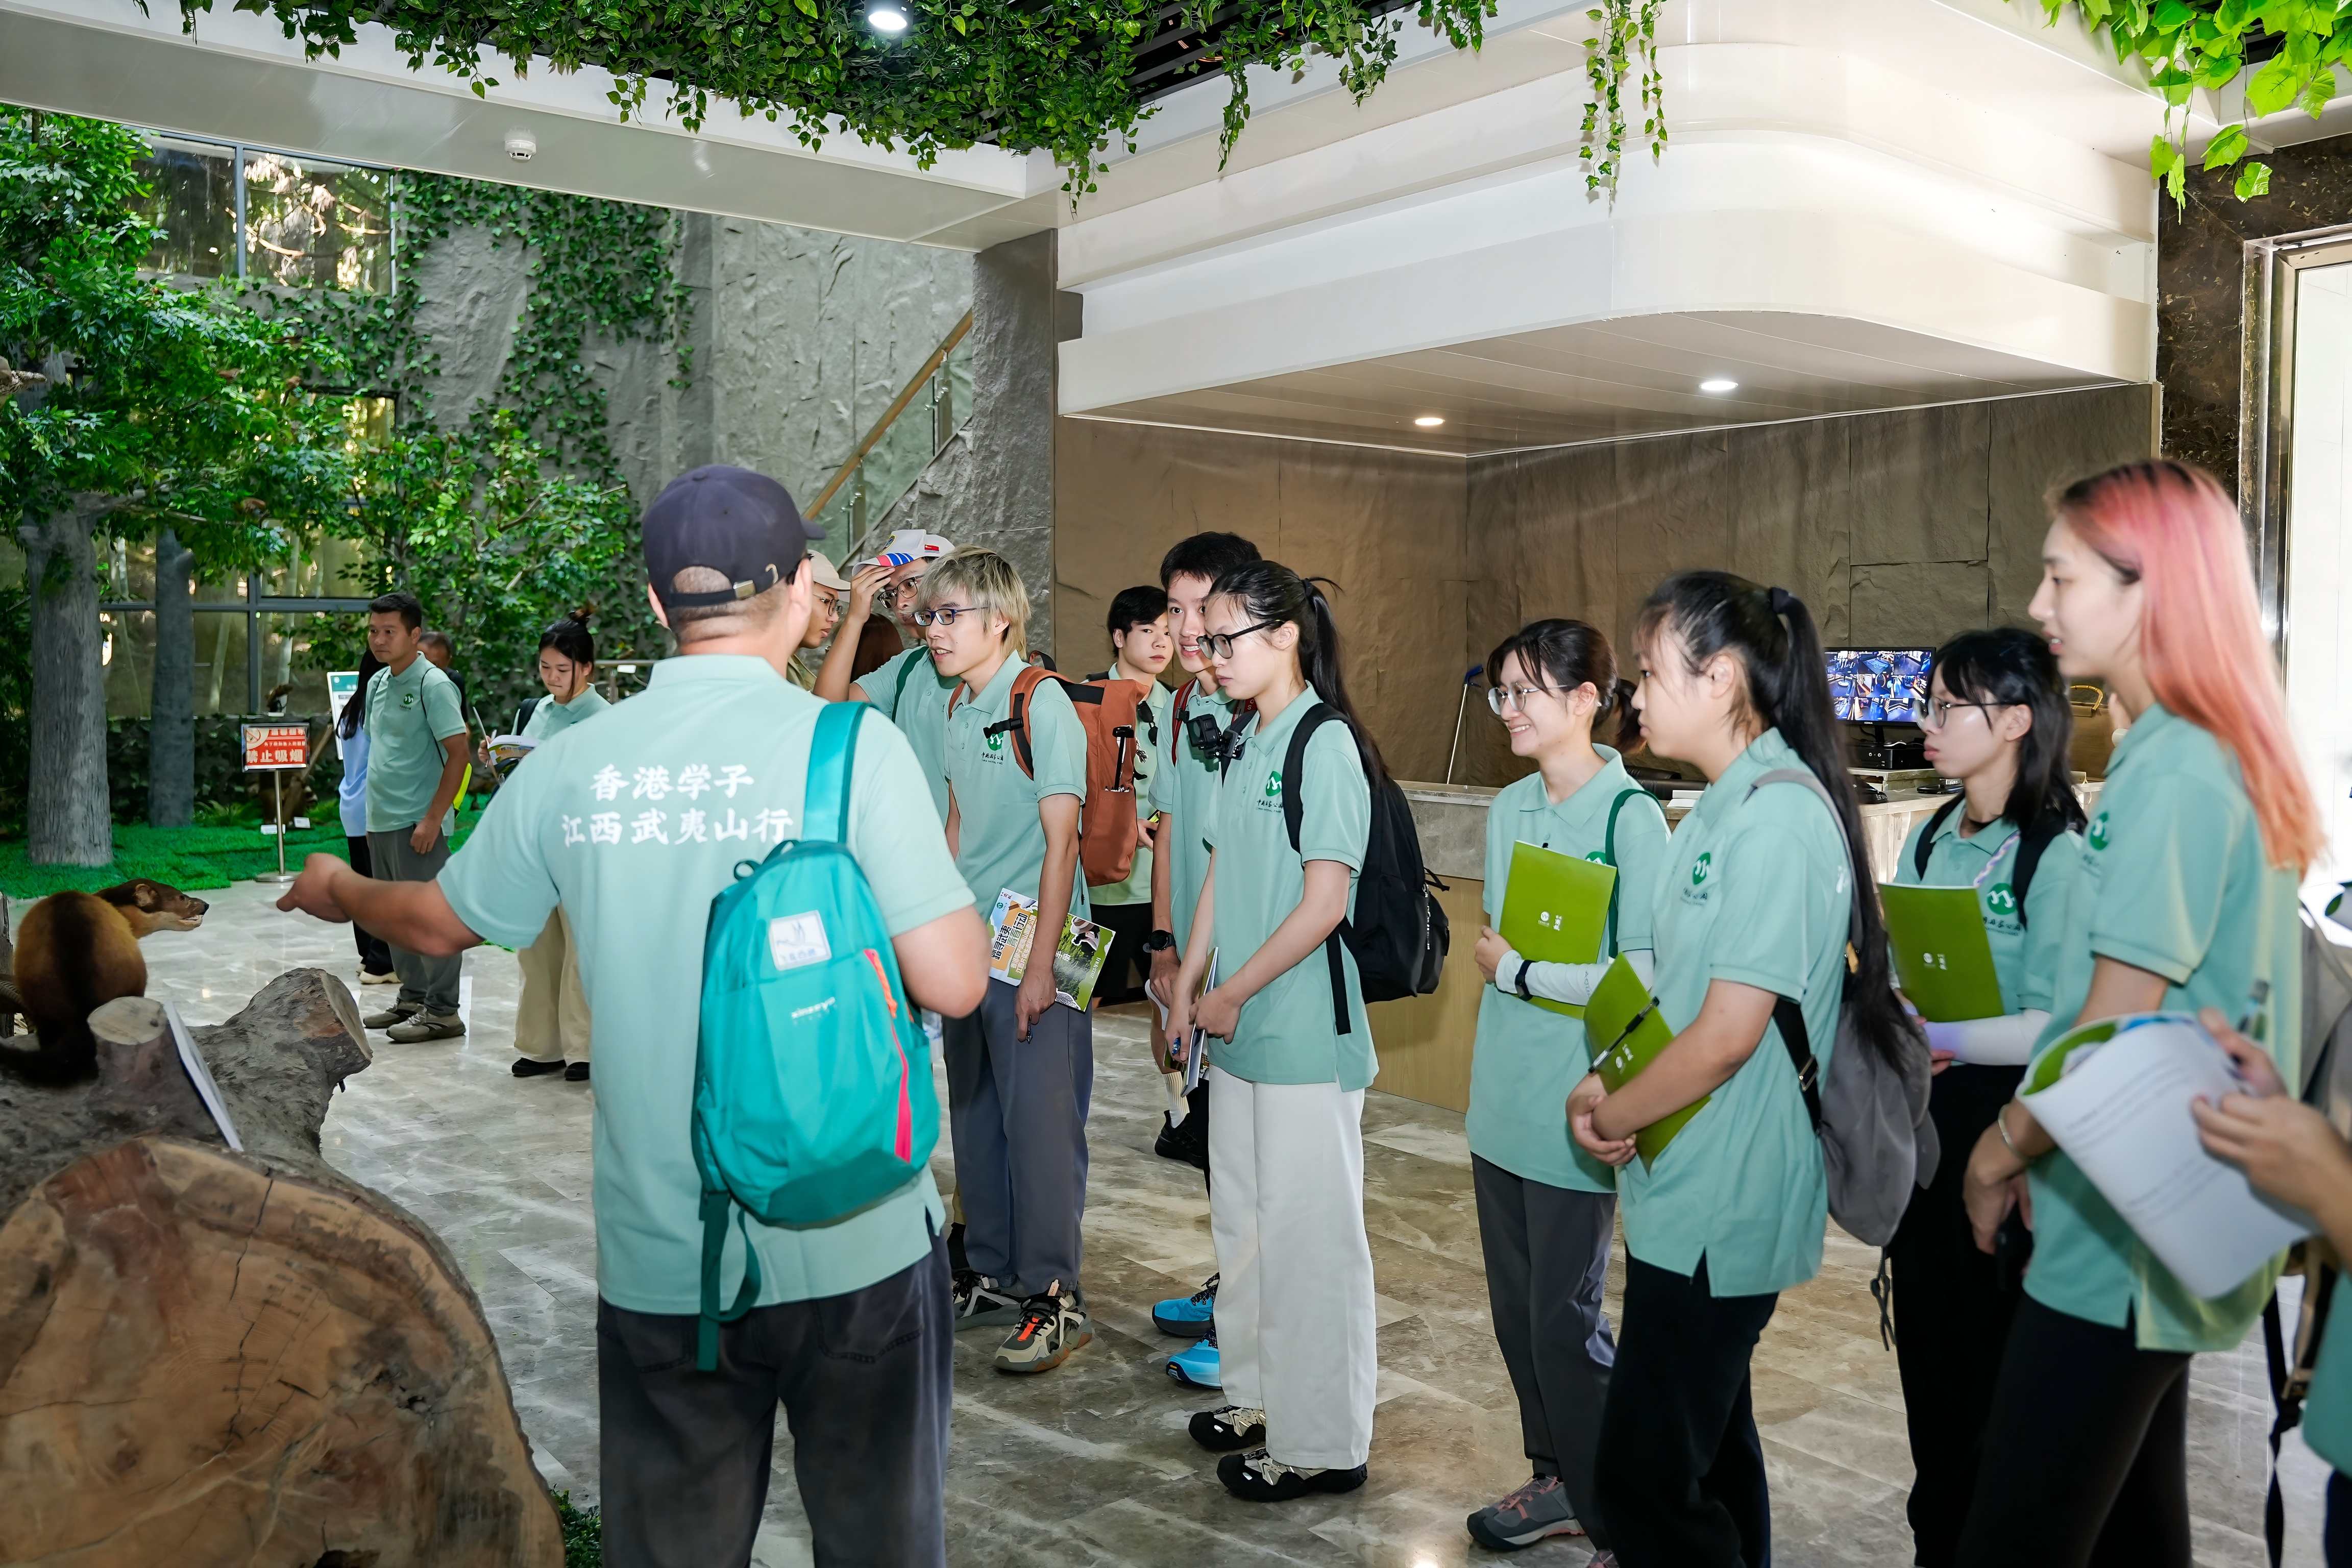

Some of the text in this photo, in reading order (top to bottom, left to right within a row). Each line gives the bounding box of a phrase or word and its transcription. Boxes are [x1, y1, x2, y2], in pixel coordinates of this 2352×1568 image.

[246, 749, 303, 763] 禁止吸烟
[590, 764, 754, 801] 香港学子
[561, 807, 794, 848] 江西武夷山行
[1007, 913, 1028, 947] 青春行动
